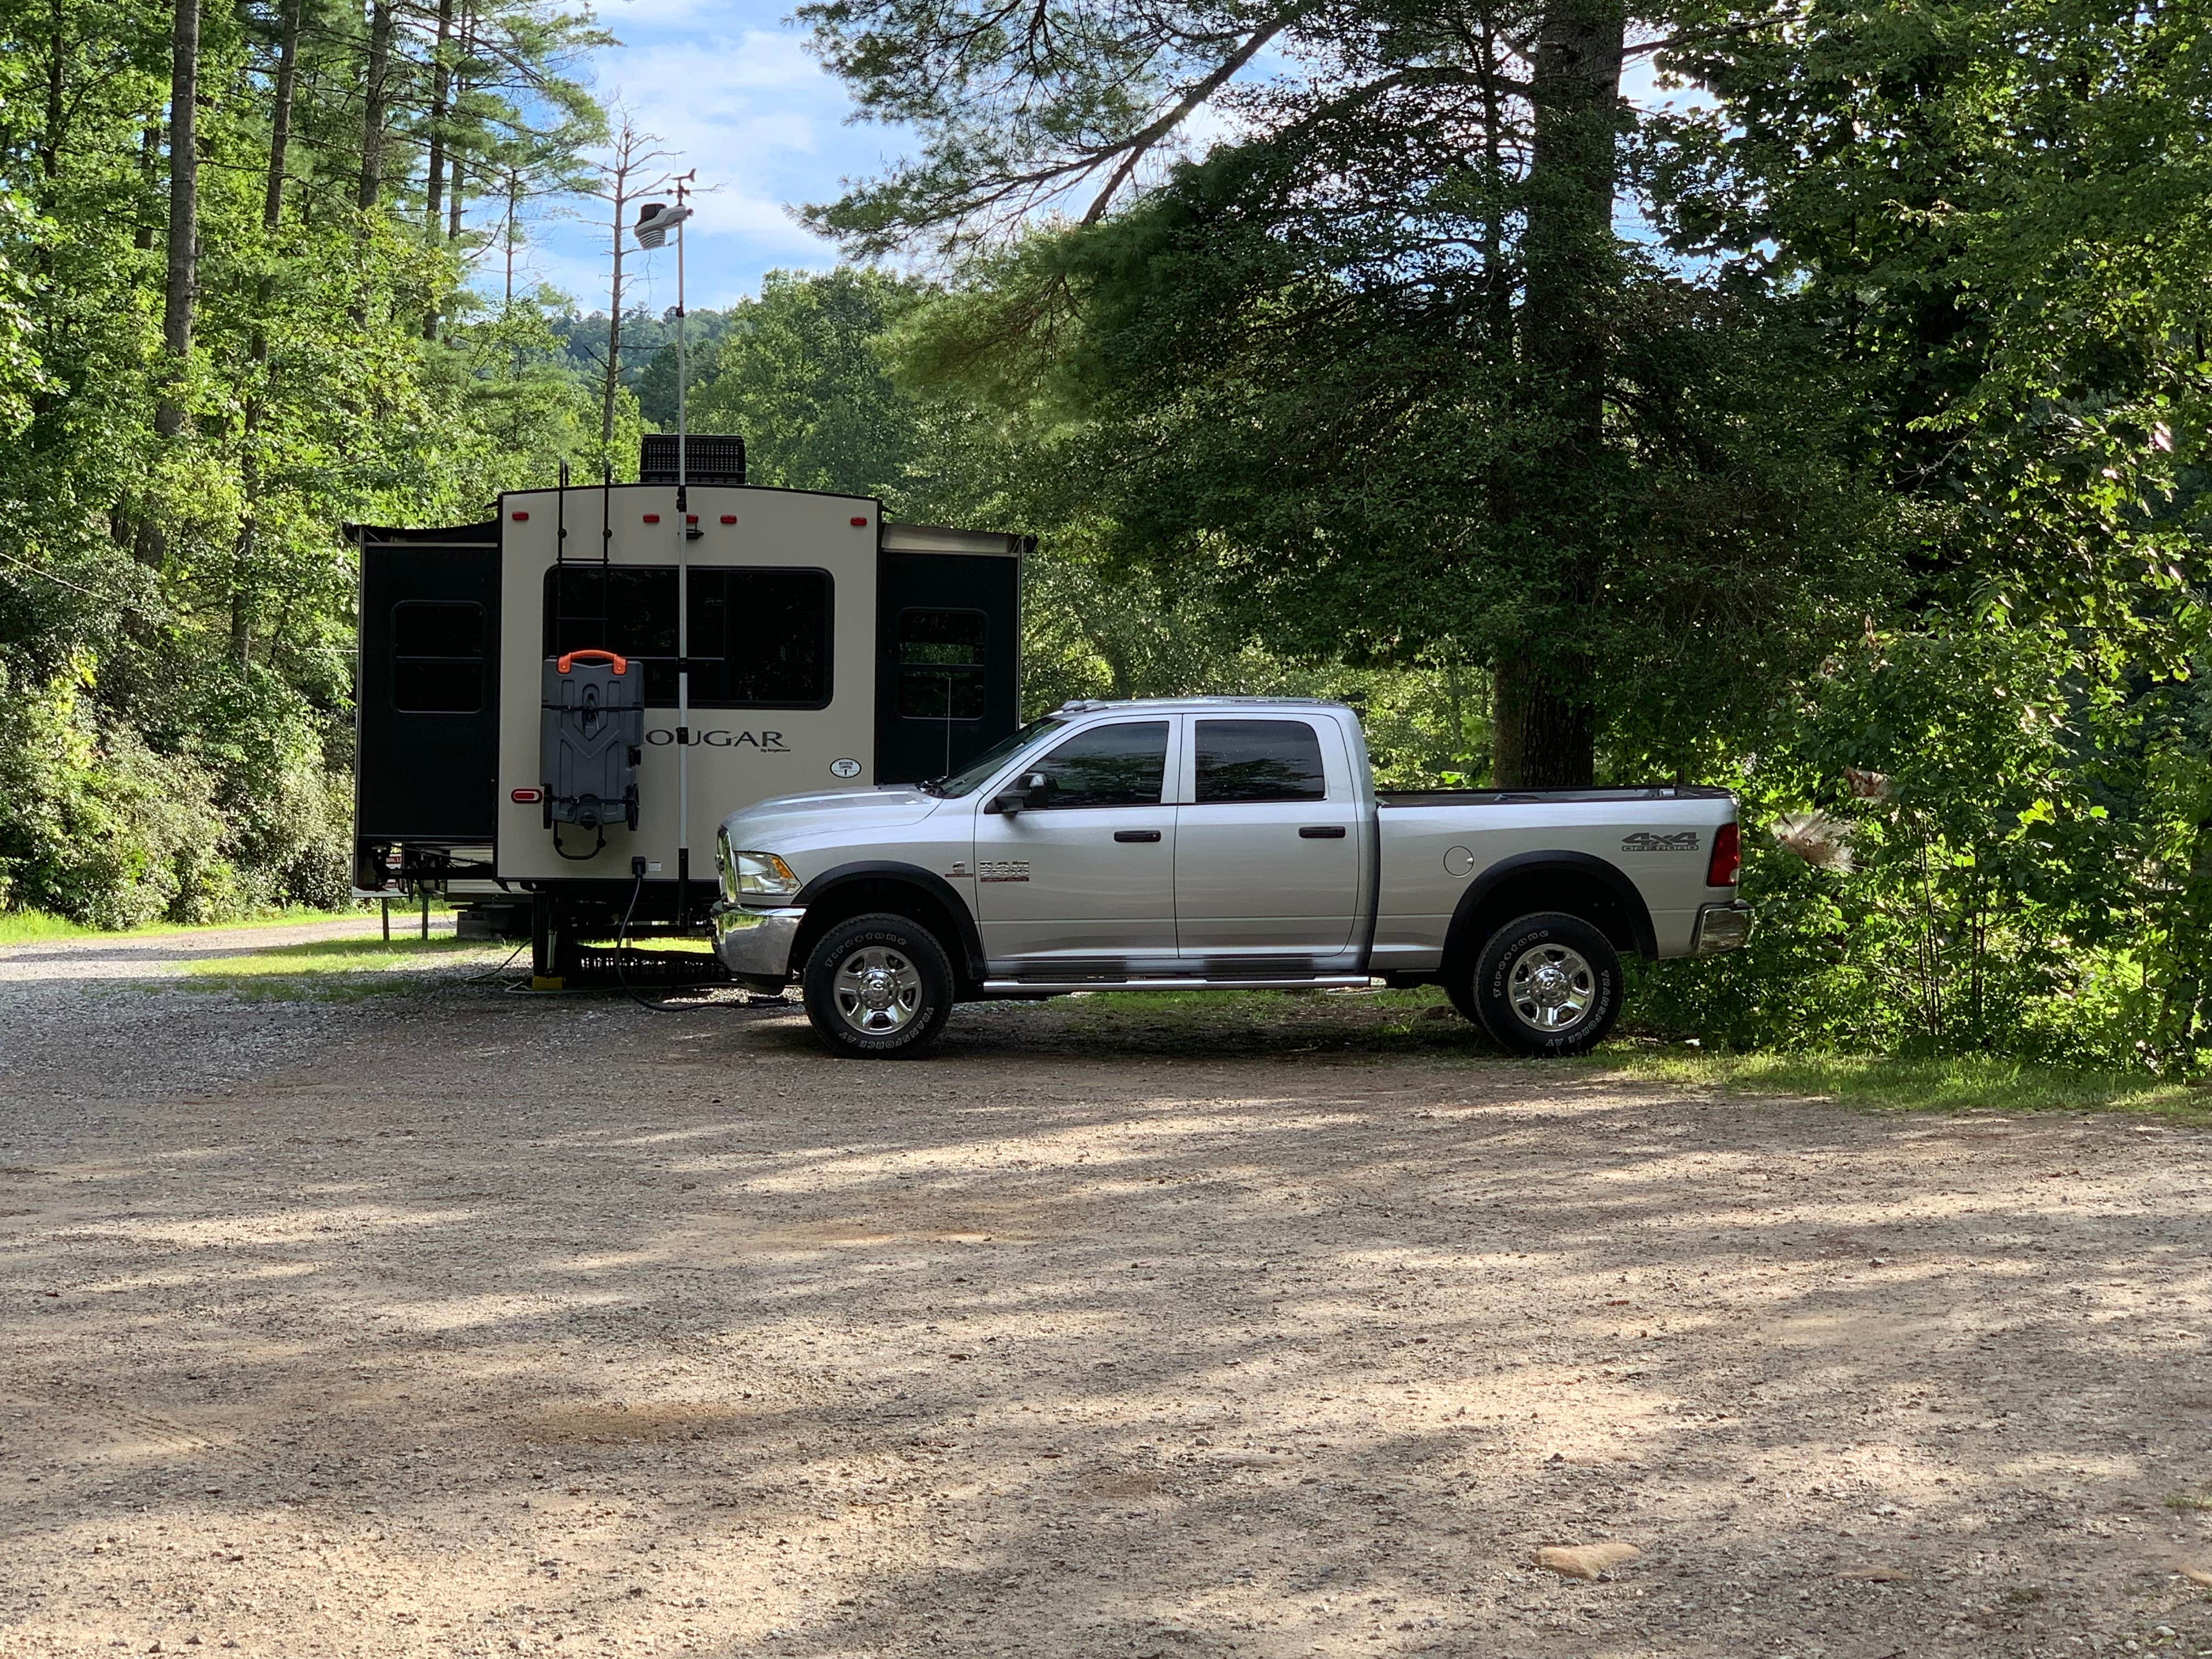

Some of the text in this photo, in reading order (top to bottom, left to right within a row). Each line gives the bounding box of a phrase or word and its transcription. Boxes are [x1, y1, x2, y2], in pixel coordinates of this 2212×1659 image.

[645, 729, 788, 747] OUGAR
[1621, 832, 1701, 845] 4x4
[980, 860, 1030, 869] RAM
[839, 1031, 857, 1043] AT
[1546, 1037, 1563, 1047] AT
